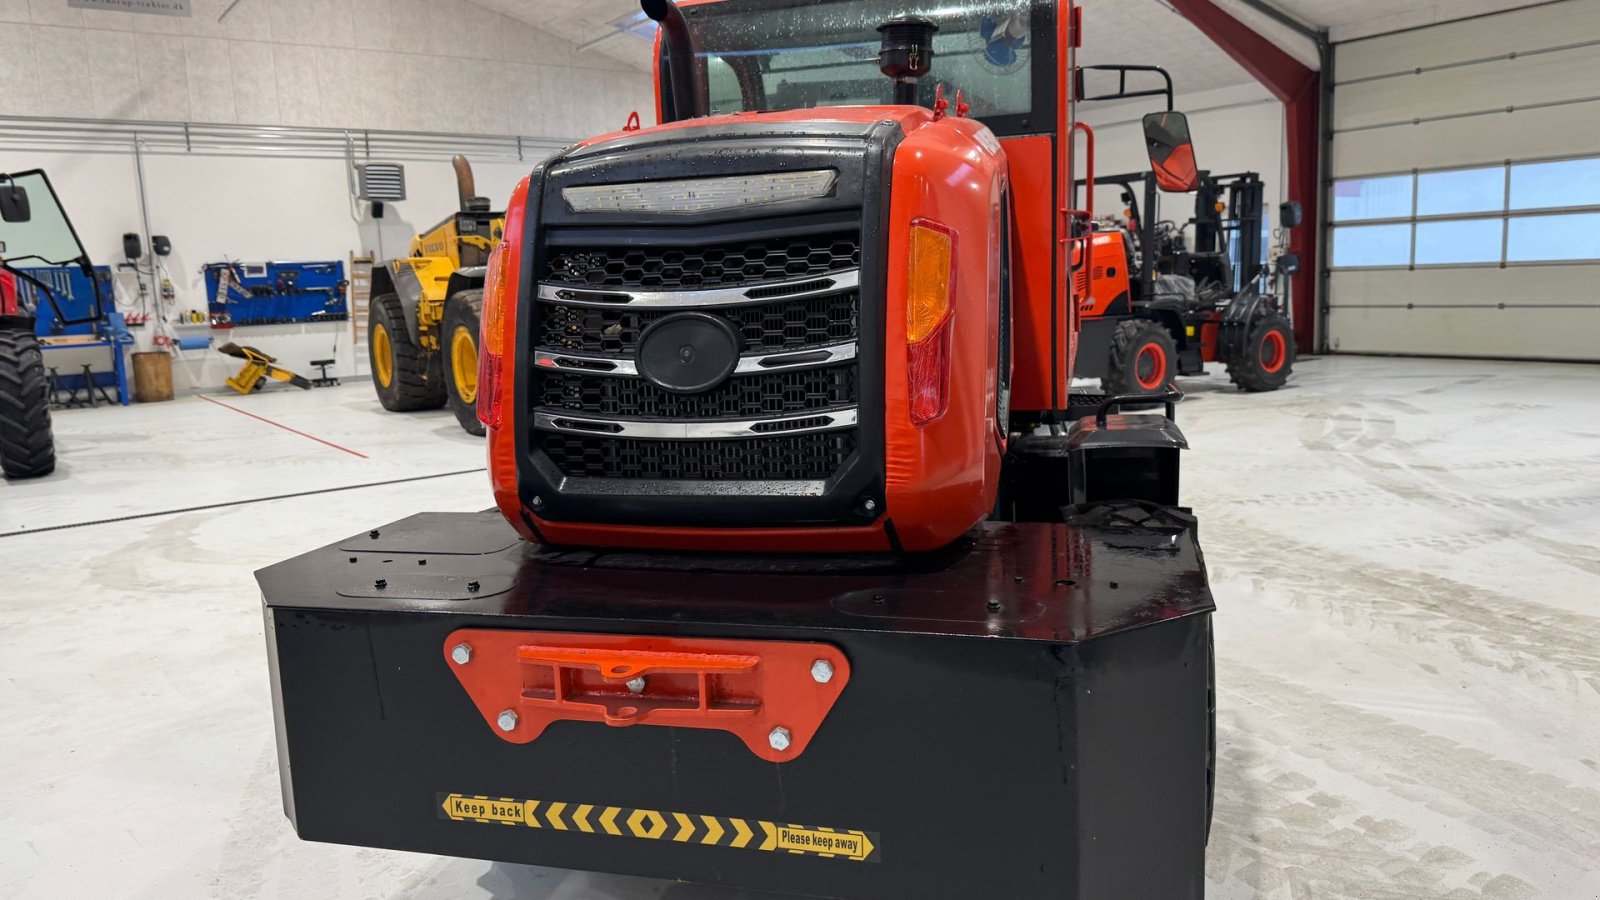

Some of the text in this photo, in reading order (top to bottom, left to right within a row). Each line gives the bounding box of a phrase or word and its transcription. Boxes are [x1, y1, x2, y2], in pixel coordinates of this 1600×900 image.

[455, 800, 522, 818] Keep back
[782, 829, 858, 853] Please keep away
